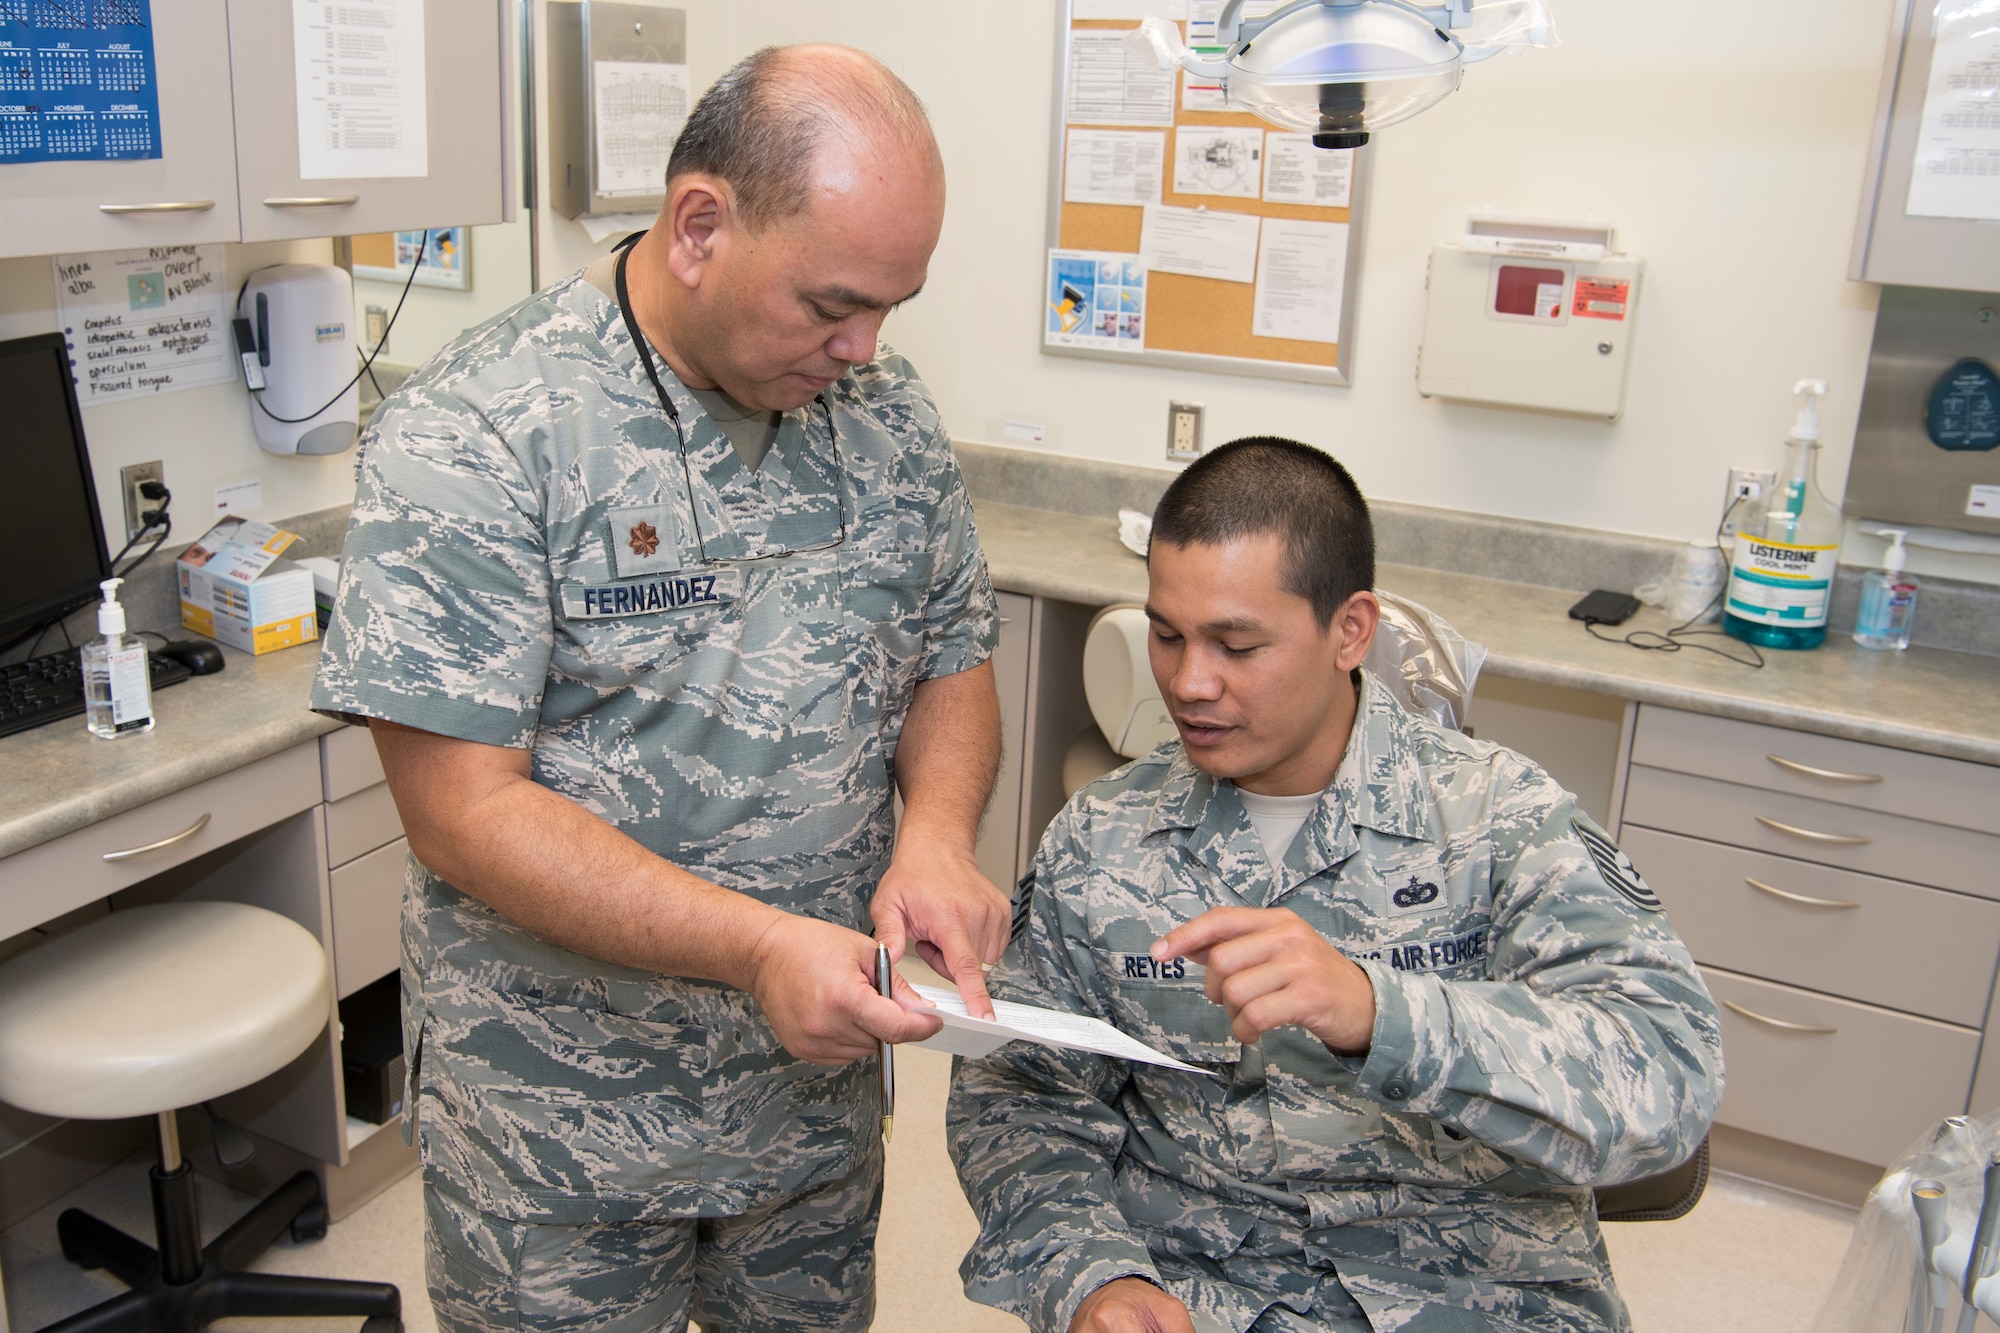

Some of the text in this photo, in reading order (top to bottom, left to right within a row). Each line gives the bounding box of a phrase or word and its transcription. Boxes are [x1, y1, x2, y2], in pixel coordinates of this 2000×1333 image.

[1750, 543, 1818, 562] LISTERINE
[1754, 558, 1780, 569] COOL
[584, 575, 717, 615] FERNANDEZ
[1391, 930, 1483, 971] AIR FORCE
[1124, 955, 1184, 978] REYES
